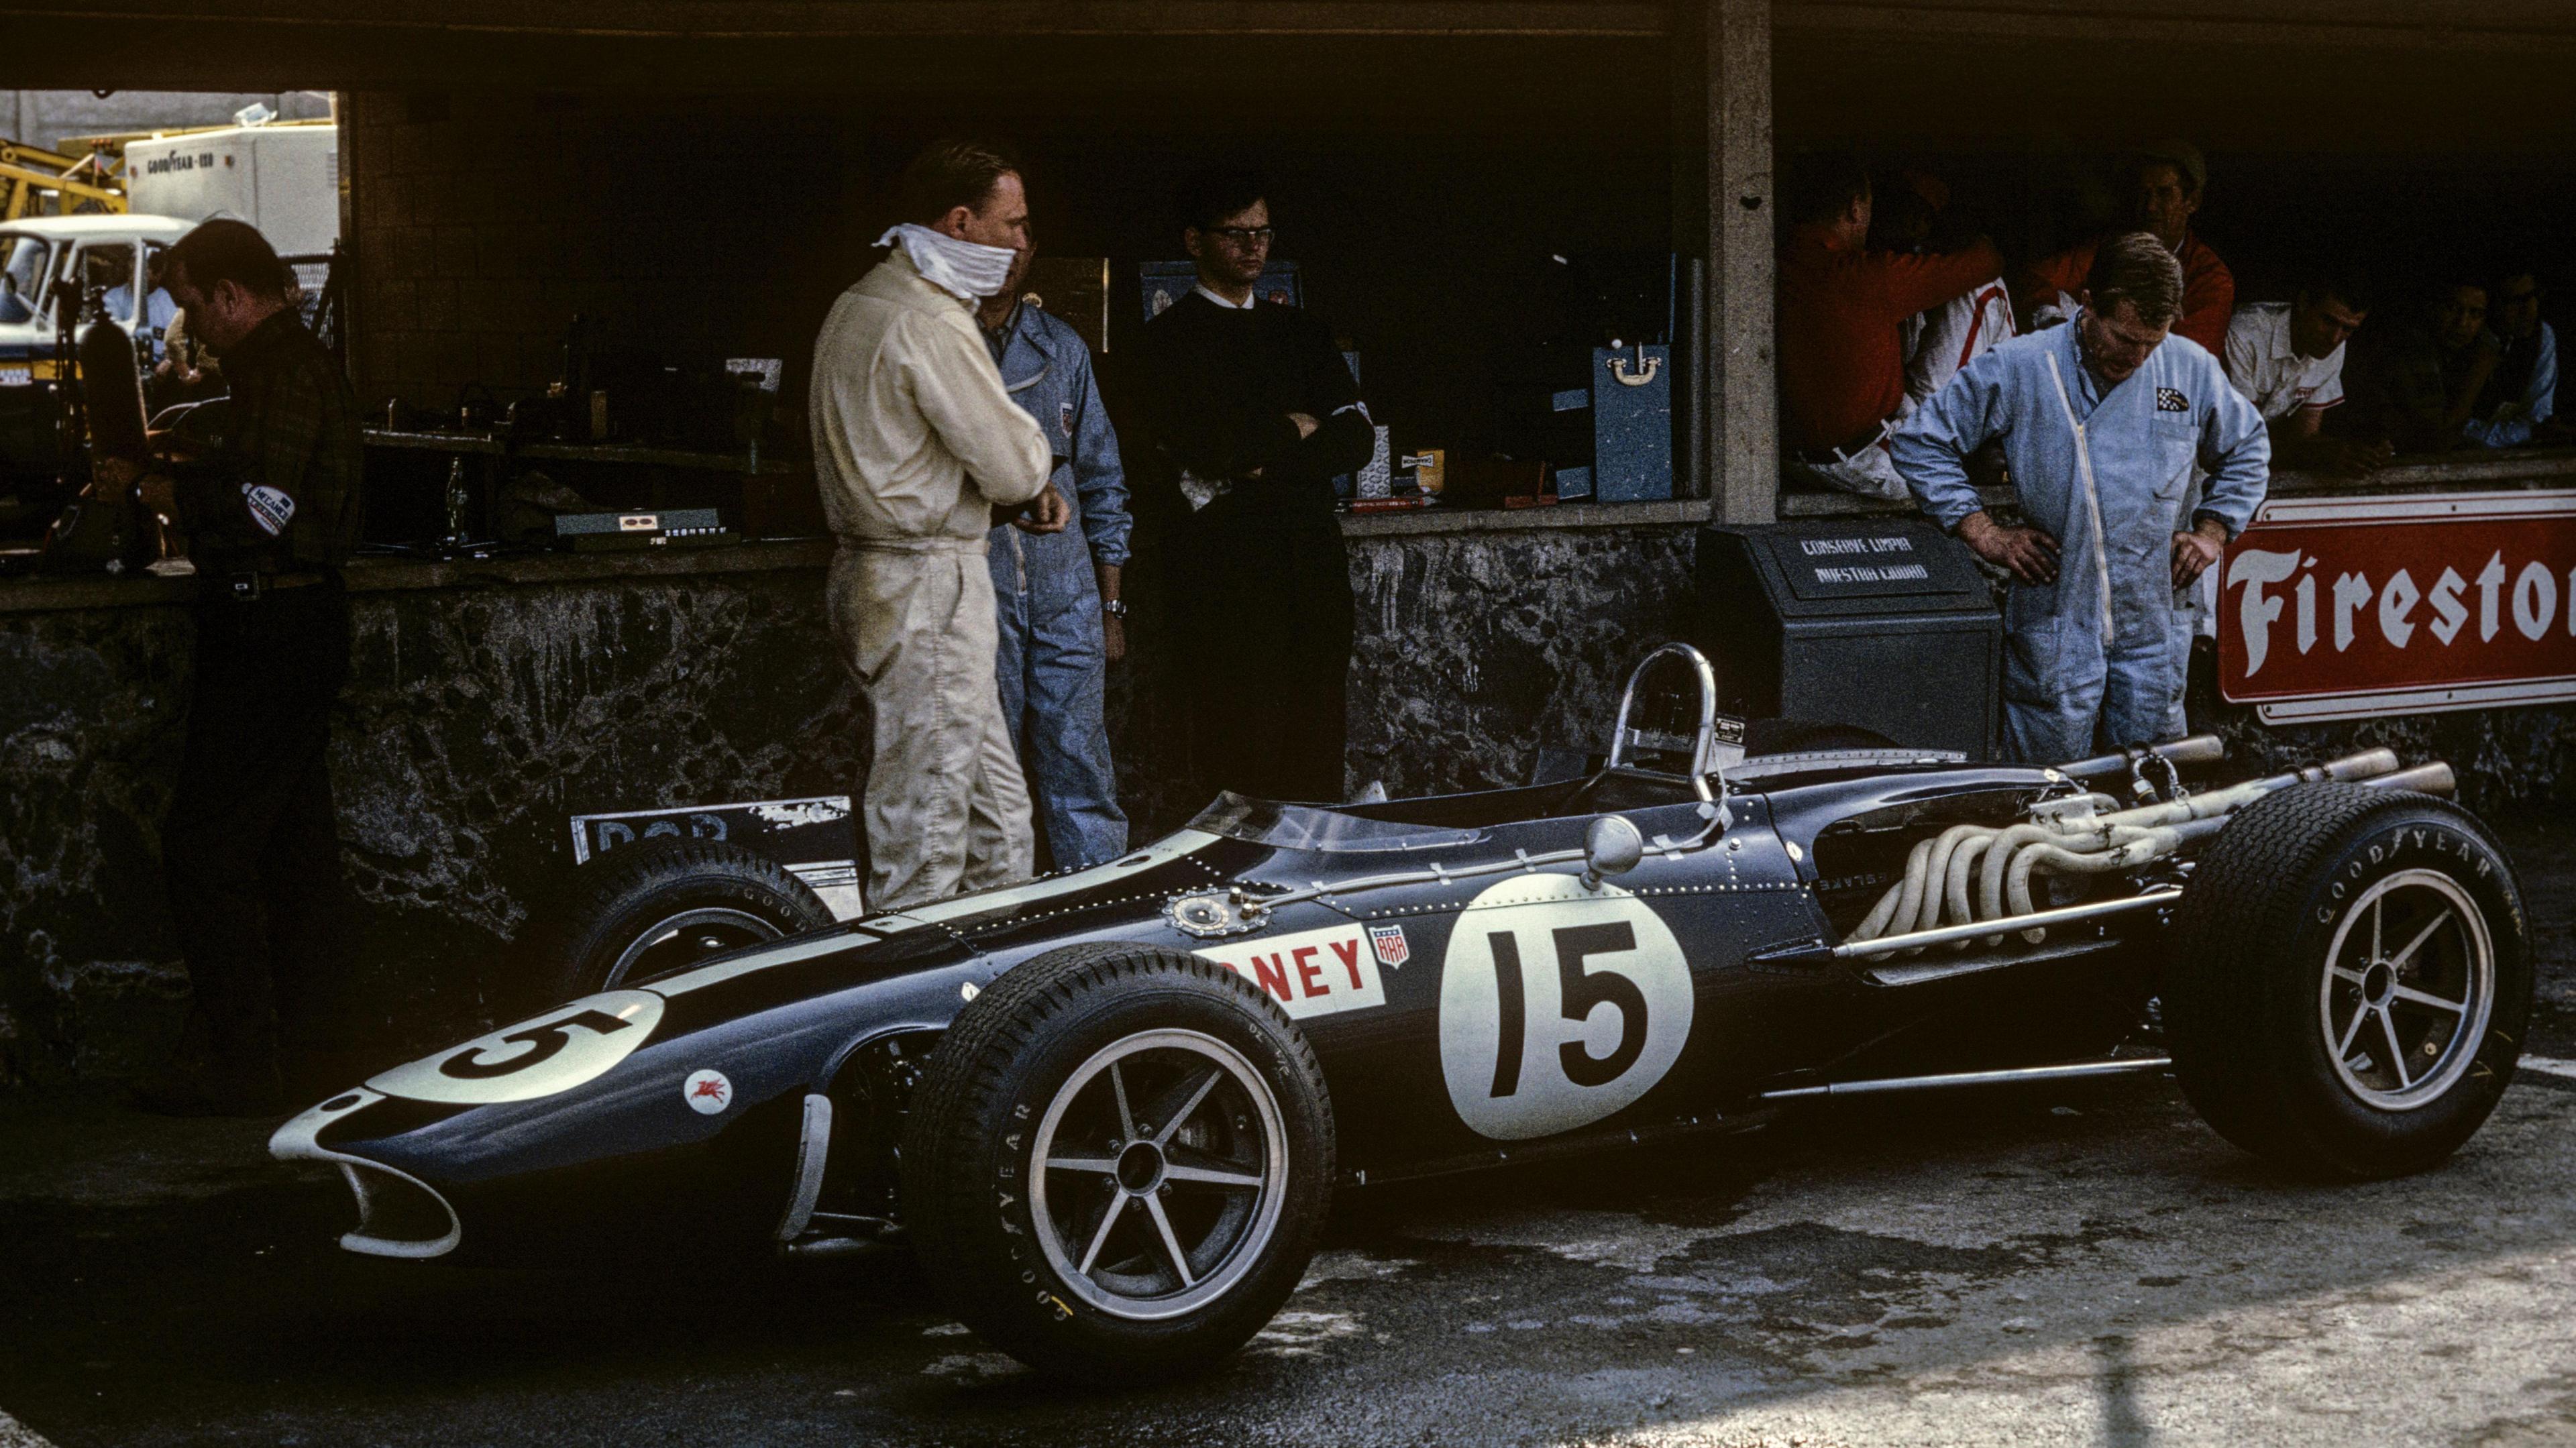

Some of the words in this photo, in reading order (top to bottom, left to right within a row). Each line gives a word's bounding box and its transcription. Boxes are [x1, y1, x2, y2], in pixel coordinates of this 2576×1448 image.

[1801, 538, 1869, 556] CONSERVE
[1868, 536, 1913, 553] LIMPIA
[1815, 566, 1880, 583] NUESTRA
[2227, 548, 2576, 678] Firesto
[2316, 826, 2491, 925] GOODYEAR
[1218, 938, 1363, 1003] NEY
[1487, 920, 1648, 1098] 15
